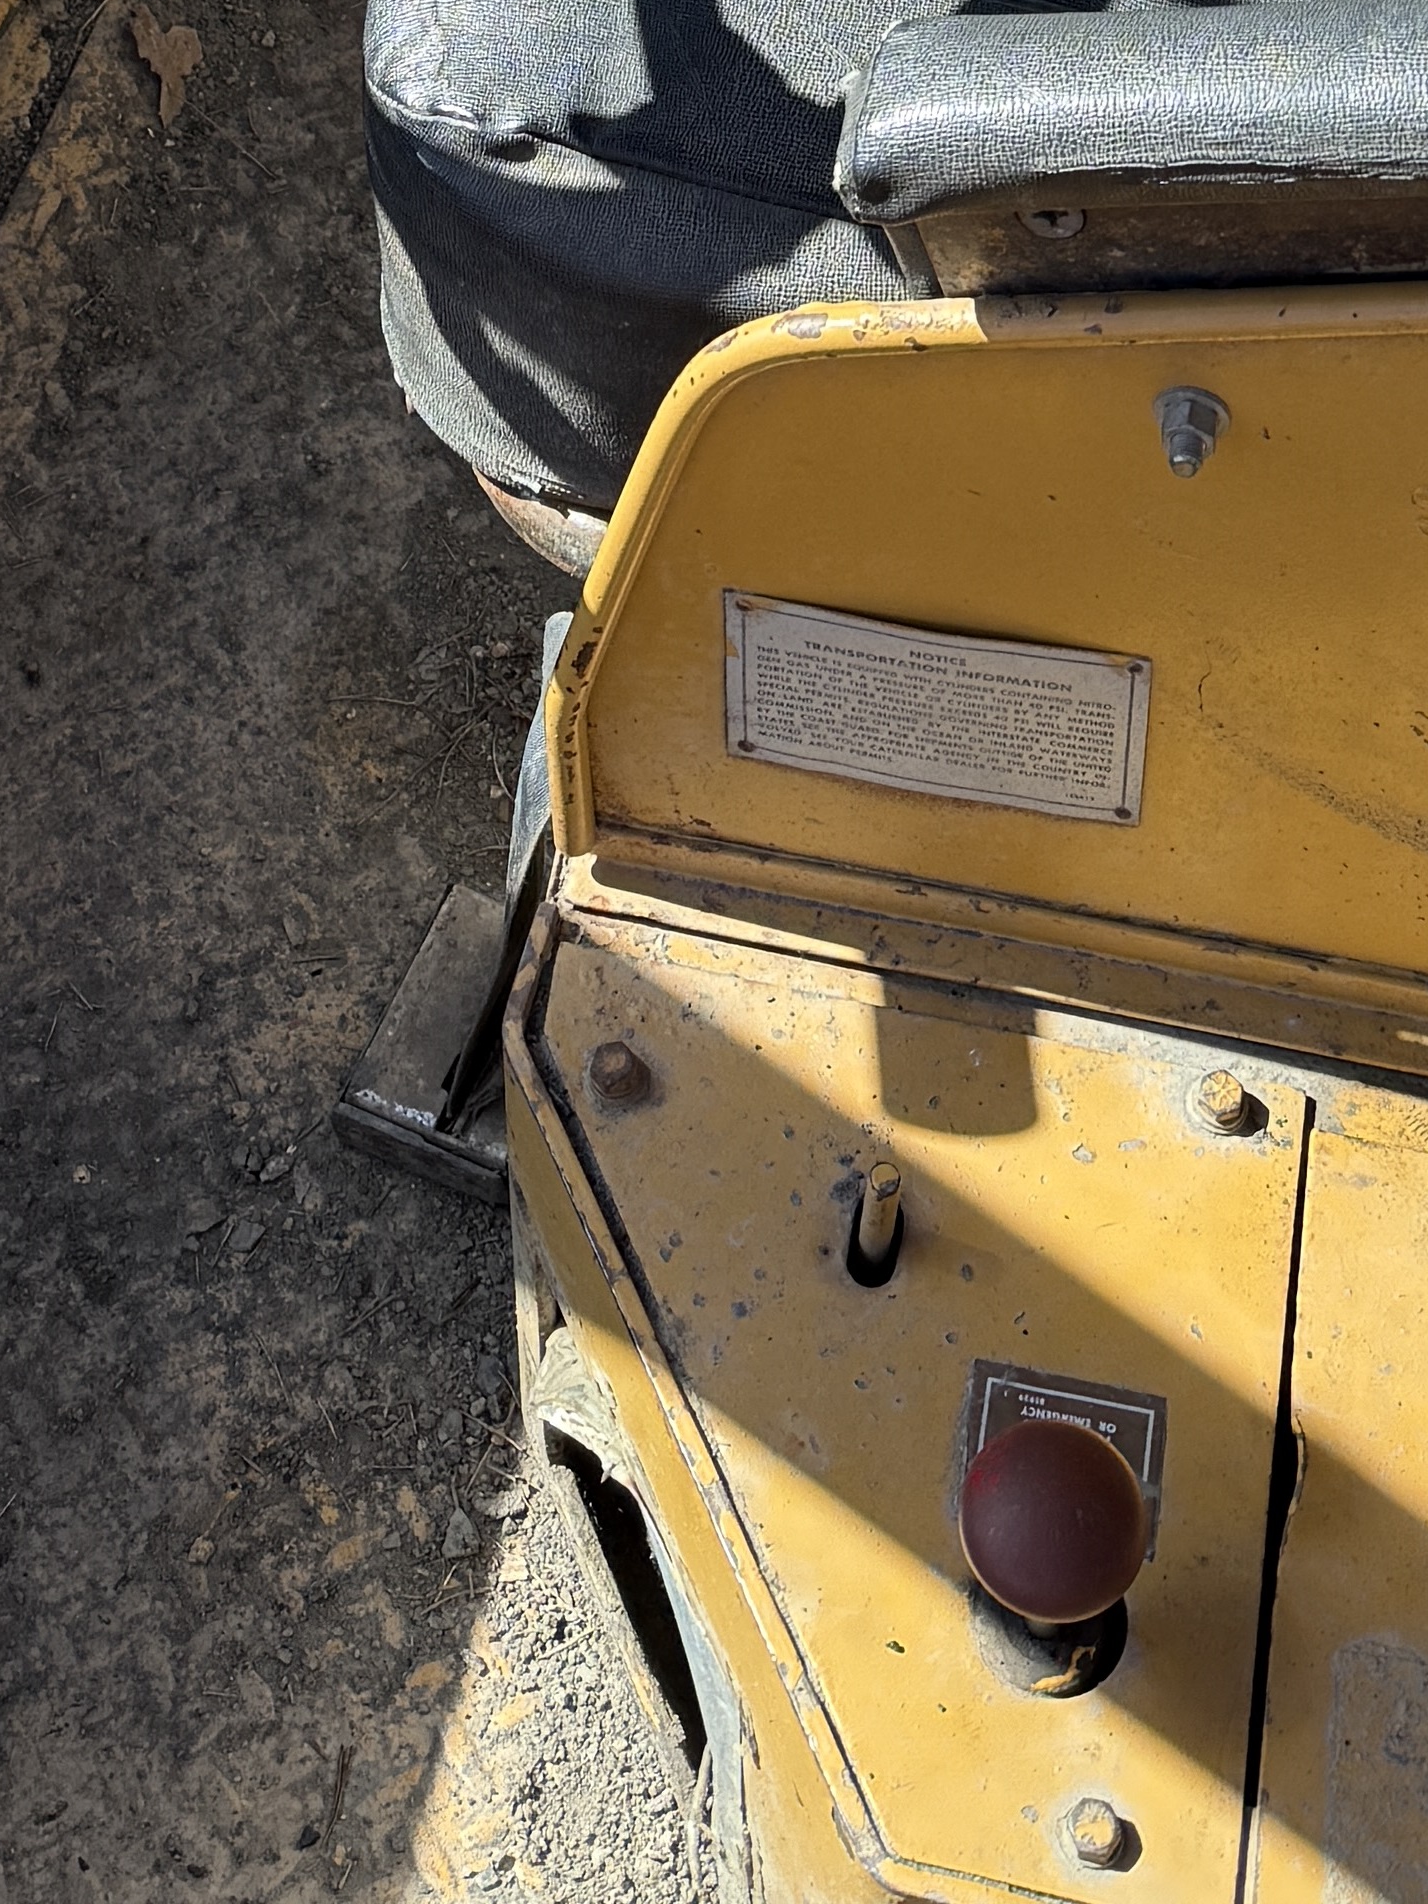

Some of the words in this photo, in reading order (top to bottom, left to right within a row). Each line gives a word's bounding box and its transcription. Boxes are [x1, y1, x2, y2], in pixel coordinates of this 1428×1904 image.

[756, 645, 779, 655] THIS
[784, 651, 827, 664] VEHICLE
[902, 673, 931, 683] WITH
[936, 679, 995, 694] CYLINDERS
[756, 654, 781, 664] GEN
[786, 660, 810, 669] GAS
[815, 666, 852, 678] UNDER
[872, 676, 925, 691] PRESSURE
[952, 690, 985, 701] MORE
[992, 697, 1023, 707] THAN
[803, 641, 947, 674] TRANSPORTATION
[956, 669, 1072, 693] INFORMATION
[908, 651, 966, 666] NOTICE
[756, 662, 822, 680] PORTATION
[828, 676, 844, 685] OF
[849, 681, 868, 689] THE
[874, 685, 918, 698] VEHICLE
[947, 698, 1008, 713] CYLINDERS
[1033, 712, 1060, 721] ANY
[1066, 717, 1115, 728] METHOD
[756, 679, 799, 693] SPECIAL
[939, 714, 1008, 731] GOVERNING
[1013, 726, 1114, 746] TRANSPORTATION
[757, 671, 792, 683] WHILE
[797, 679, 817, 688] THE
[881, 695, 934, 710] PRESSURE
[1035, 721, 1062, 730] WILL
[1067, 725, 1114, 737] REQUIRE
[757, 730, 803, 744] MATION
[807, 740, 844, 752] ABOUT
[799, 714, 836, 726] COAST
[887, 731, 909, 740] FOR
[1049, 758, 1068, 766] THE
[822, 701, 842, 710] ARE
[850, 707, 918, 725] ESTABLISHED
[950, 725, 970, 733] THE
[978, 729, 1040, 745] INTERSTATE
[1048, 740, 1113, 755] COMMERCE
[841, 714, 867, 724] AND
[871, 719, 890, 728] ON
[896, 724, 916, 733] THE
[968, 736, 984, 744] OR
[1039, 748, 1112, 763] WATERWAYS
[851, 732, 926, 752] APPROPRIATE
[932, 747, 980, 761] AGENCY
[1007, 760, 1025, 768] THE
[1032, 764, 1087, 777] COUNTRY
[991, 766, 1012, 774] FOR
[1020, 1405, 1092, 1429] EMERGENCY
[1098, 1421, 1117, 1434] OR
